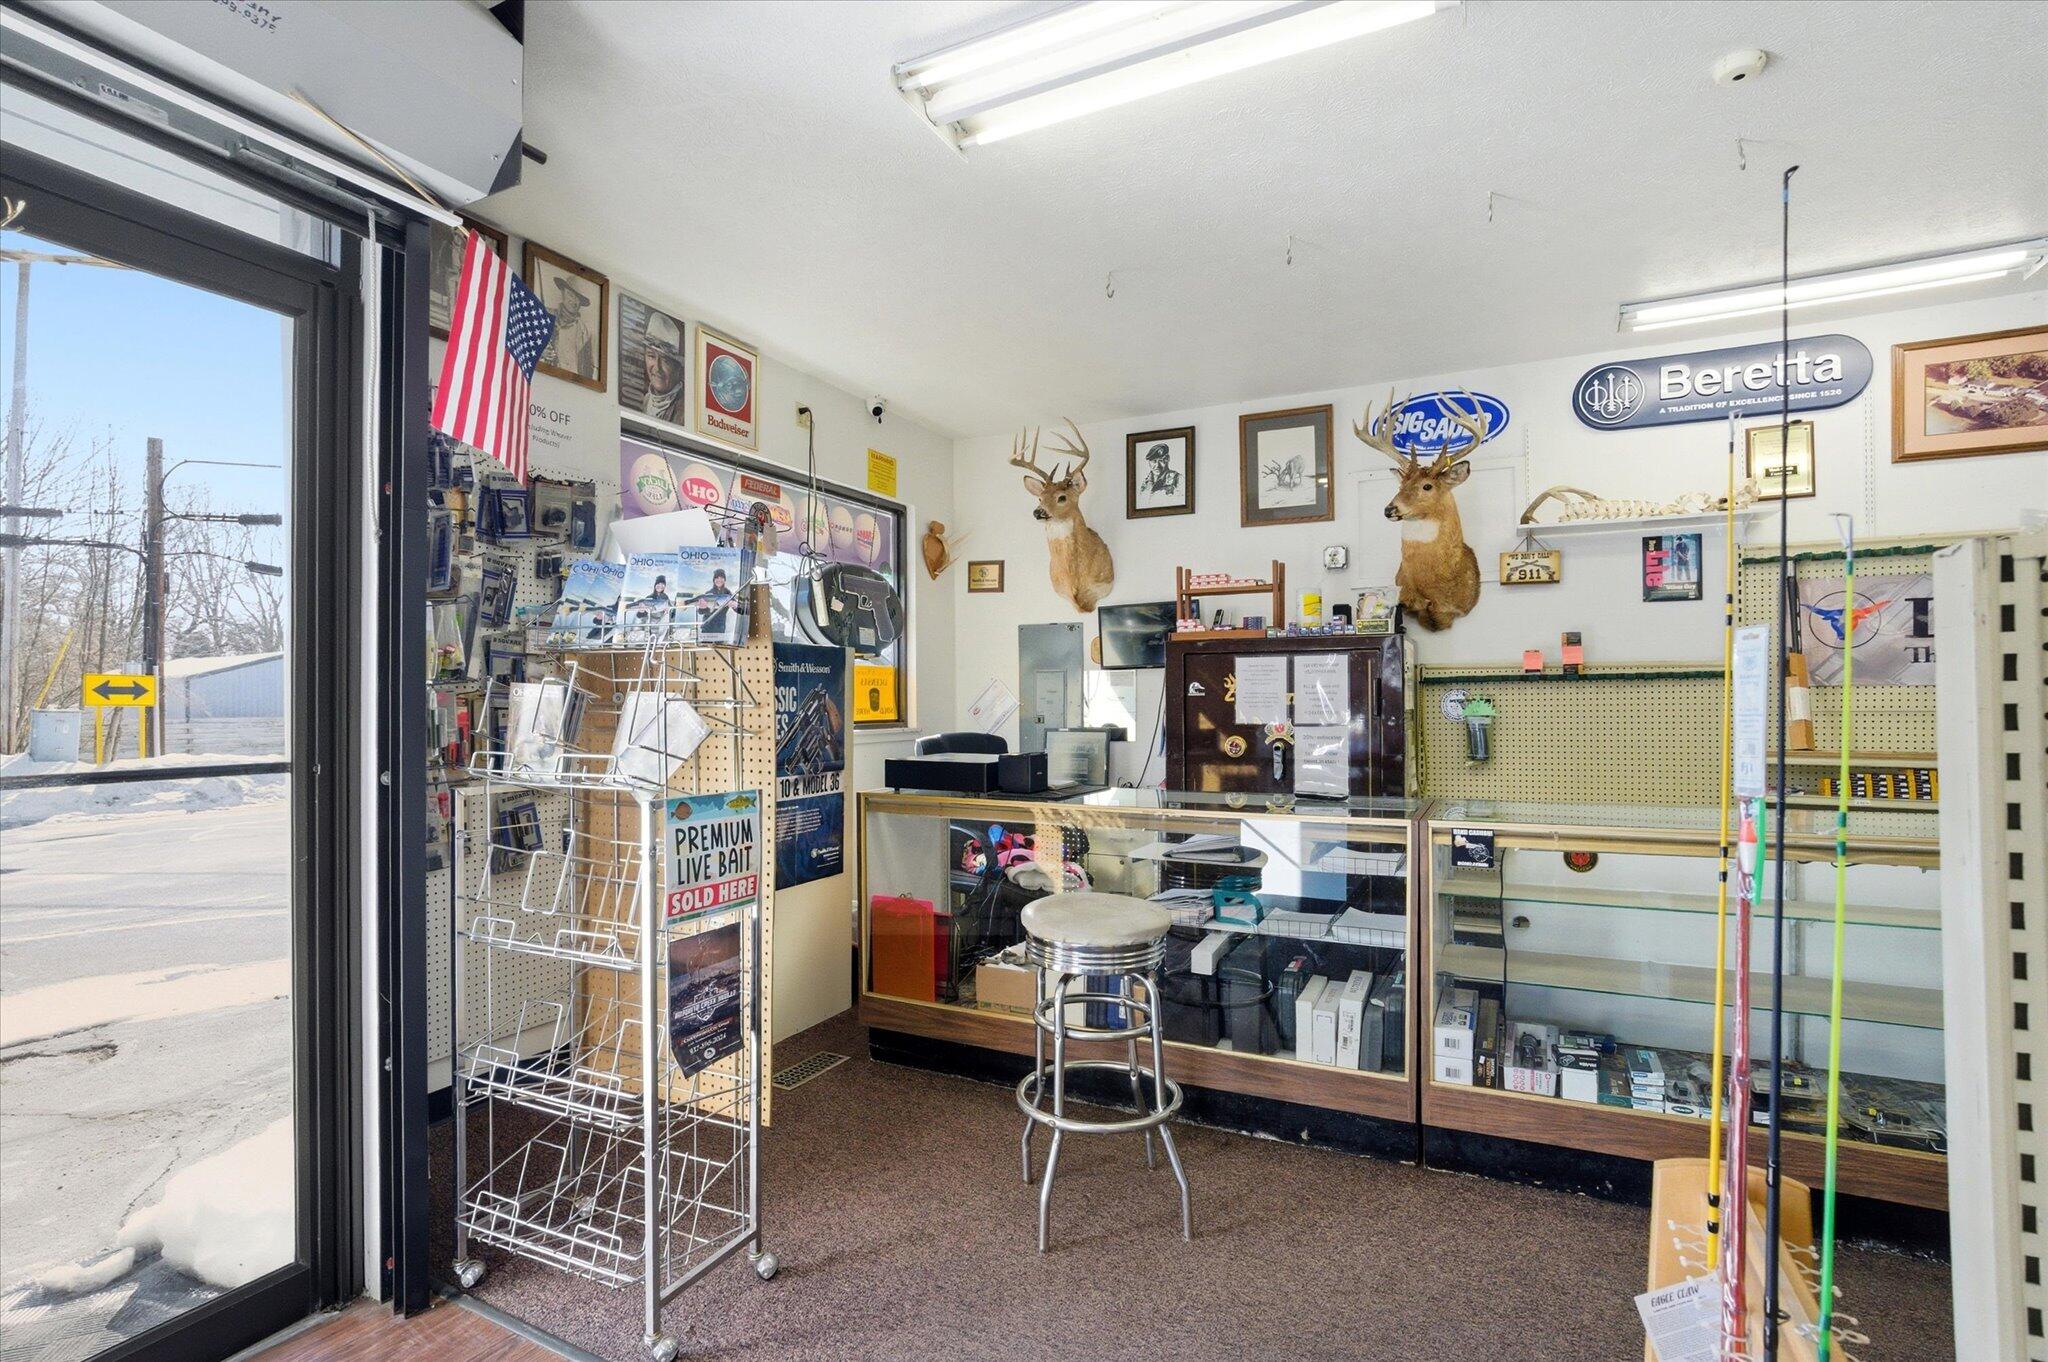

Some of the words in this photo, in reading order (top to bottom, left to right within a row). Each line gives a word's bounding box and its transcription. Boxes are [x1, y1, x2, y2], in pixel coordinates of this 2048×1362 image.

[1659, 350, 1843, 400] Beretta
[1668, 403, 1714, 413] TRADITION
[1789, 391, 1818, 400] SINCE
[529, 403, 547, 419] 0%
[550, 410, 571, 426] OFF
[707, 414, 750, 438] Budweiser
[1392, 411, 1425, 434] SIG
[1419, 412, 1493, 443] SAUR
[744, 478, 777, 497] FEDERAL
[630, 557, 654, 567] OHIO
[681, 551, 709, 561] OHIO
[581, 563, 599, 575] OHI
[602, 565, 625, 579] OHIO
[1518, 568, 1542, 580] 911
[780, 778, 790, 798] 10
[793, 778, 800, 797] &
[802, 775, 828, 795] MODEL
[830, 773, 840, 791] 36
[675, 818, 753, 856] PREMIUM
[678, 853, 711, 886] LIVE
[719, 846, 753, 878] BAIT
[671, 886, 714, 915] SOLD
[719, 877, 756, 904] HERE
[1651, 1292, 1675, 1308] EAGLE
[1677, 1284, 1700, 1299] CLAW
